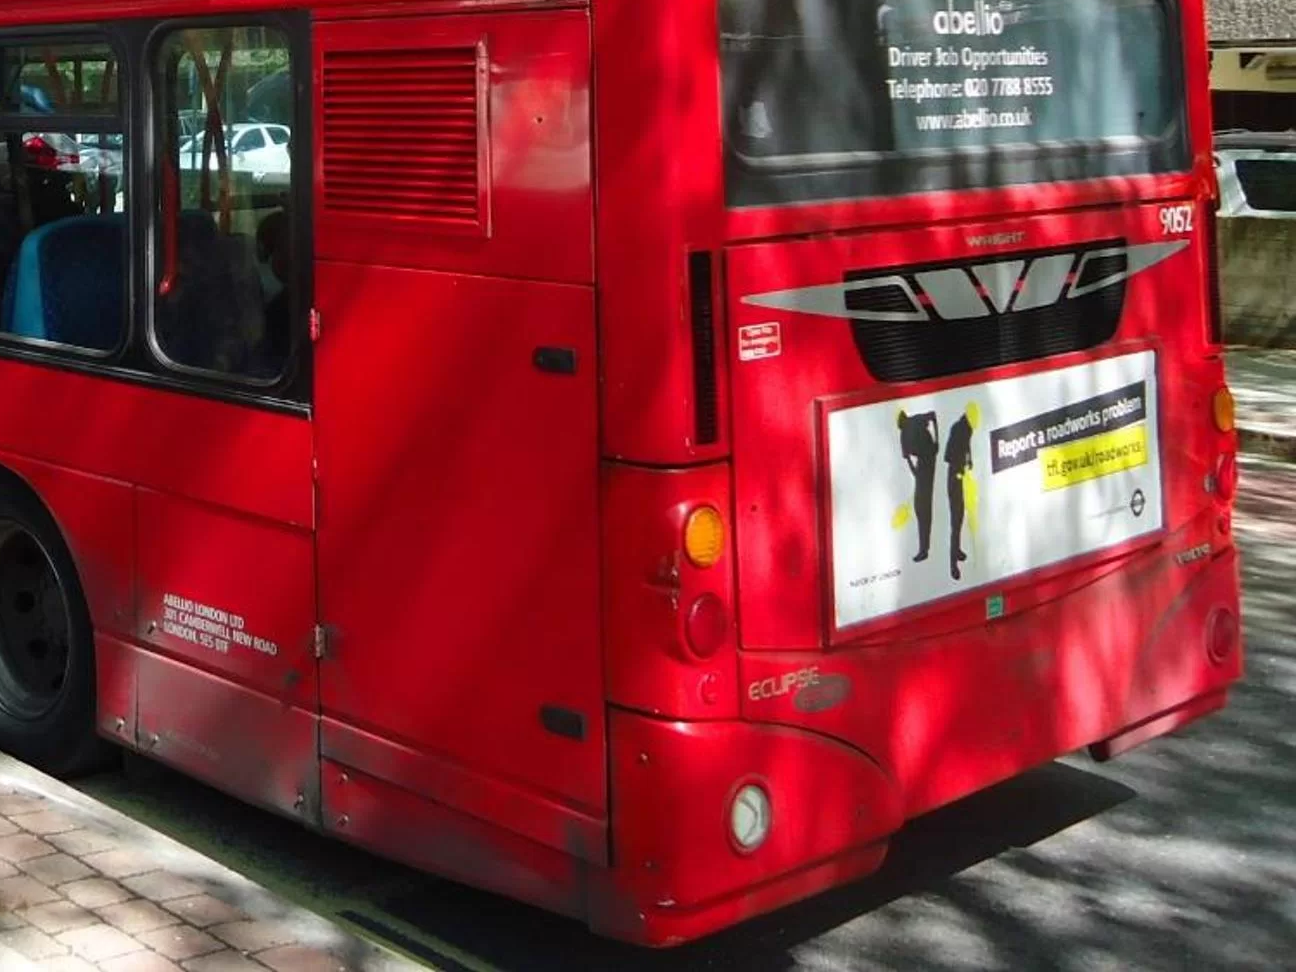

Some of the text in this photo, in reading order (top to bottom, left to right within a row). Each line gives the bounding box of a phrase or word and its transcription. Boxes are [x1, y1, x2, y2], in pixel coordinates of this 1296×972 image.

[932, 0, 1004, 36] abellio
[888, 45, 1049, 71] Driver Job Opportunities
[885, 78, 963, 104] Telephone:
[964, 78, 988, 97] 020
[1023, 76, 1054, 96] 8555
[915, 106, 1033, 131] www.abellio.co.uk
[1159, 205, 1194, 236] 9052
[997, 395, 1143, 459] Report a roadworks problem
[163, 593, 245, 629] ABELLIO LONDON LTD
[179, 611, 231, 641] CAMBERWELL
[233, 629, 253, 648] NEW
[253, 636, 278, 657] ROAD
[199, 632, 214, 649] SE5
[748, 666, 821, 701] ECLIPSE
